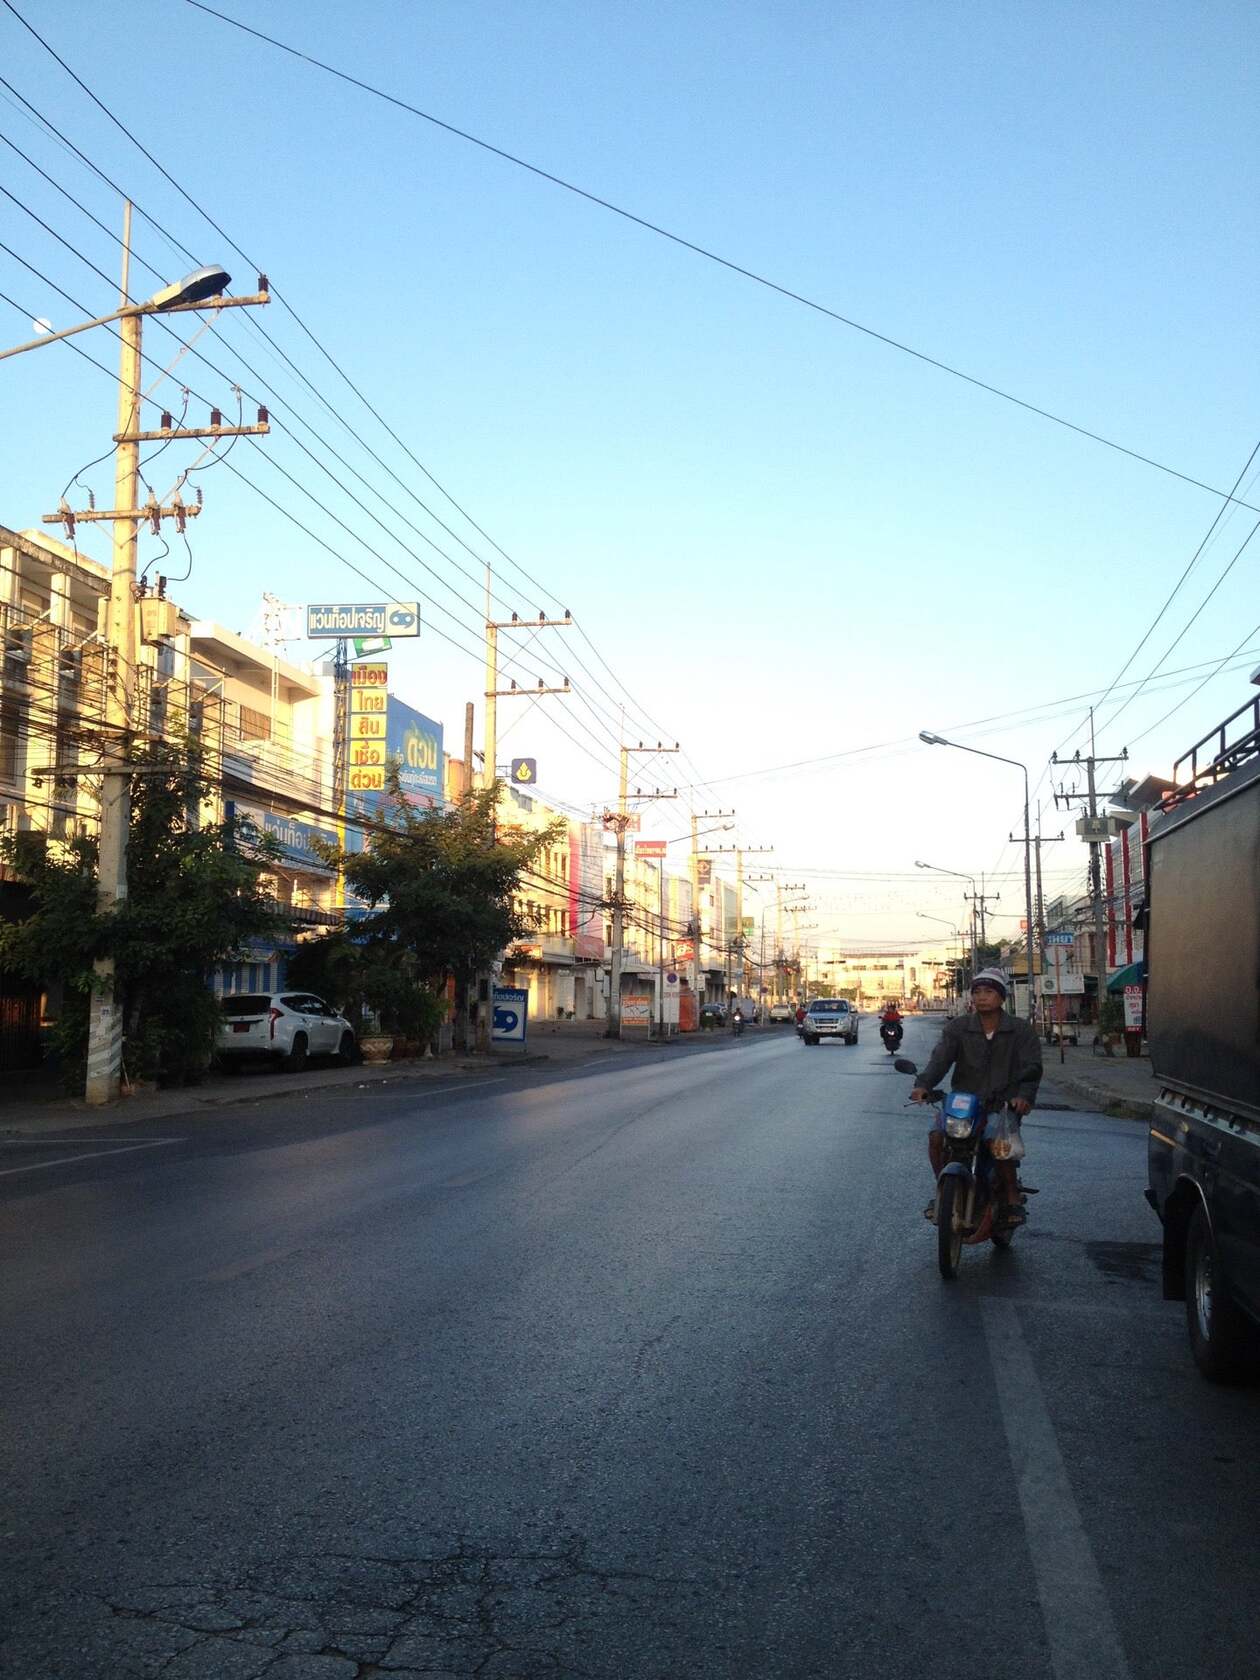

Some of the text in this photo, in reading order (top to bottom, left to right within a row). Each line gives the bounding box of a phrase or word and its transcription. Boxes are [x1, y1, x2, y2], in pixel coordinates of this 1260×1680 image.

[310, 607, 385, 632] แว่นท็อปเจริญ
[357, 689, 384, 711] ไทย
[359, 717, 380, 735] สิน
